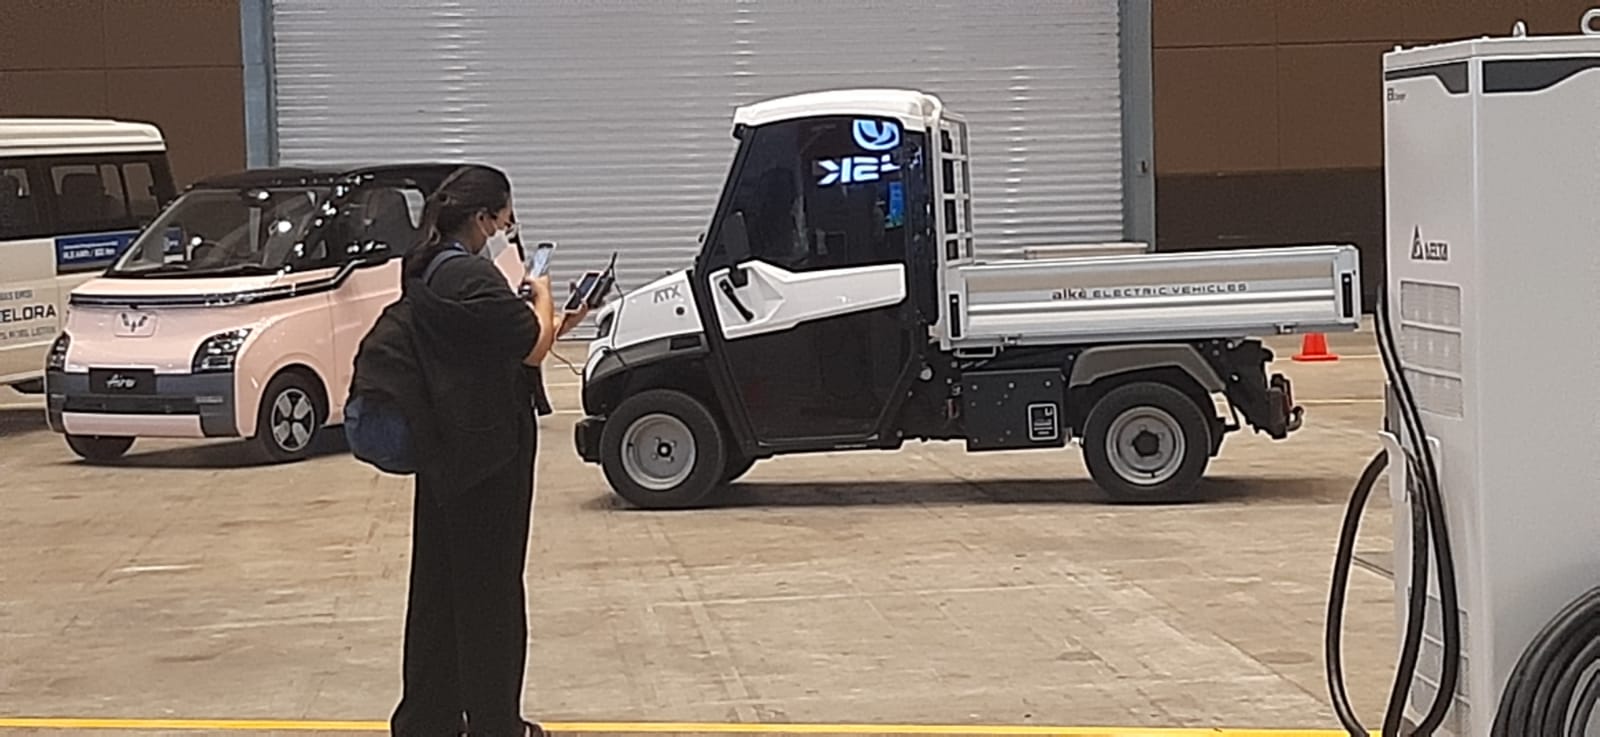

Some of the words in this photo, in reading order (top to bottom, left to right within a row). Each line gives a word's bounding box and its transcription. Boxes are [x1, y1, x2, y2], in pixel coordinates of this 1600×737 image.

[1093, 284, 1167, 298] ELECTRIC
[1172, 283, 1247, 295] VEHICLES
[0, 303, 56, 323] ELORA
